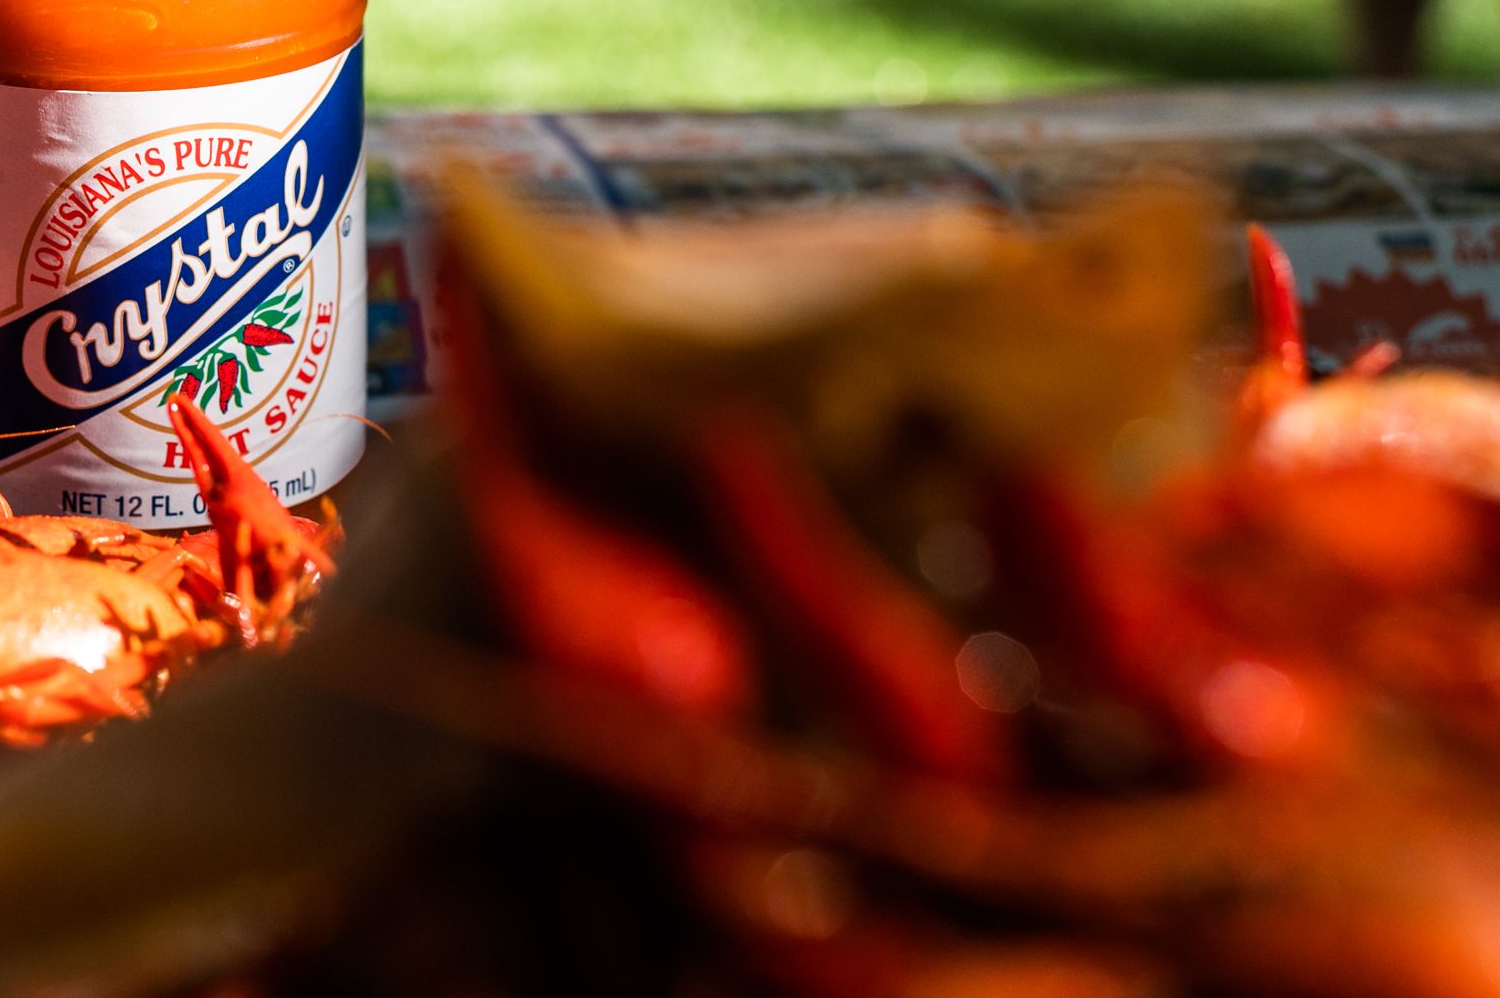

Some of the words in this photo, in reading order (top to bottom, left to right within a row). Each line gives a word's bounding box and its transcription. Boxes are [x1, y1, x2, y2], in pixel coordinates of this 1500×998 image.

[22, 139, 324, 410] Crystal
[30, 147, 165, 290] LOUISIANA'S
[173, 137, 253, 171] PURE
[162, 427, 250, 469] HT
[264, 301, 333, 434] SAUCE
[62, 490, 107, 516] NET
[115, 495, 143, 517] 12
[151, 495, 184, 517] FL.
[192, 492, 208, 515] O
[285, 468, 316, 497] mL)
